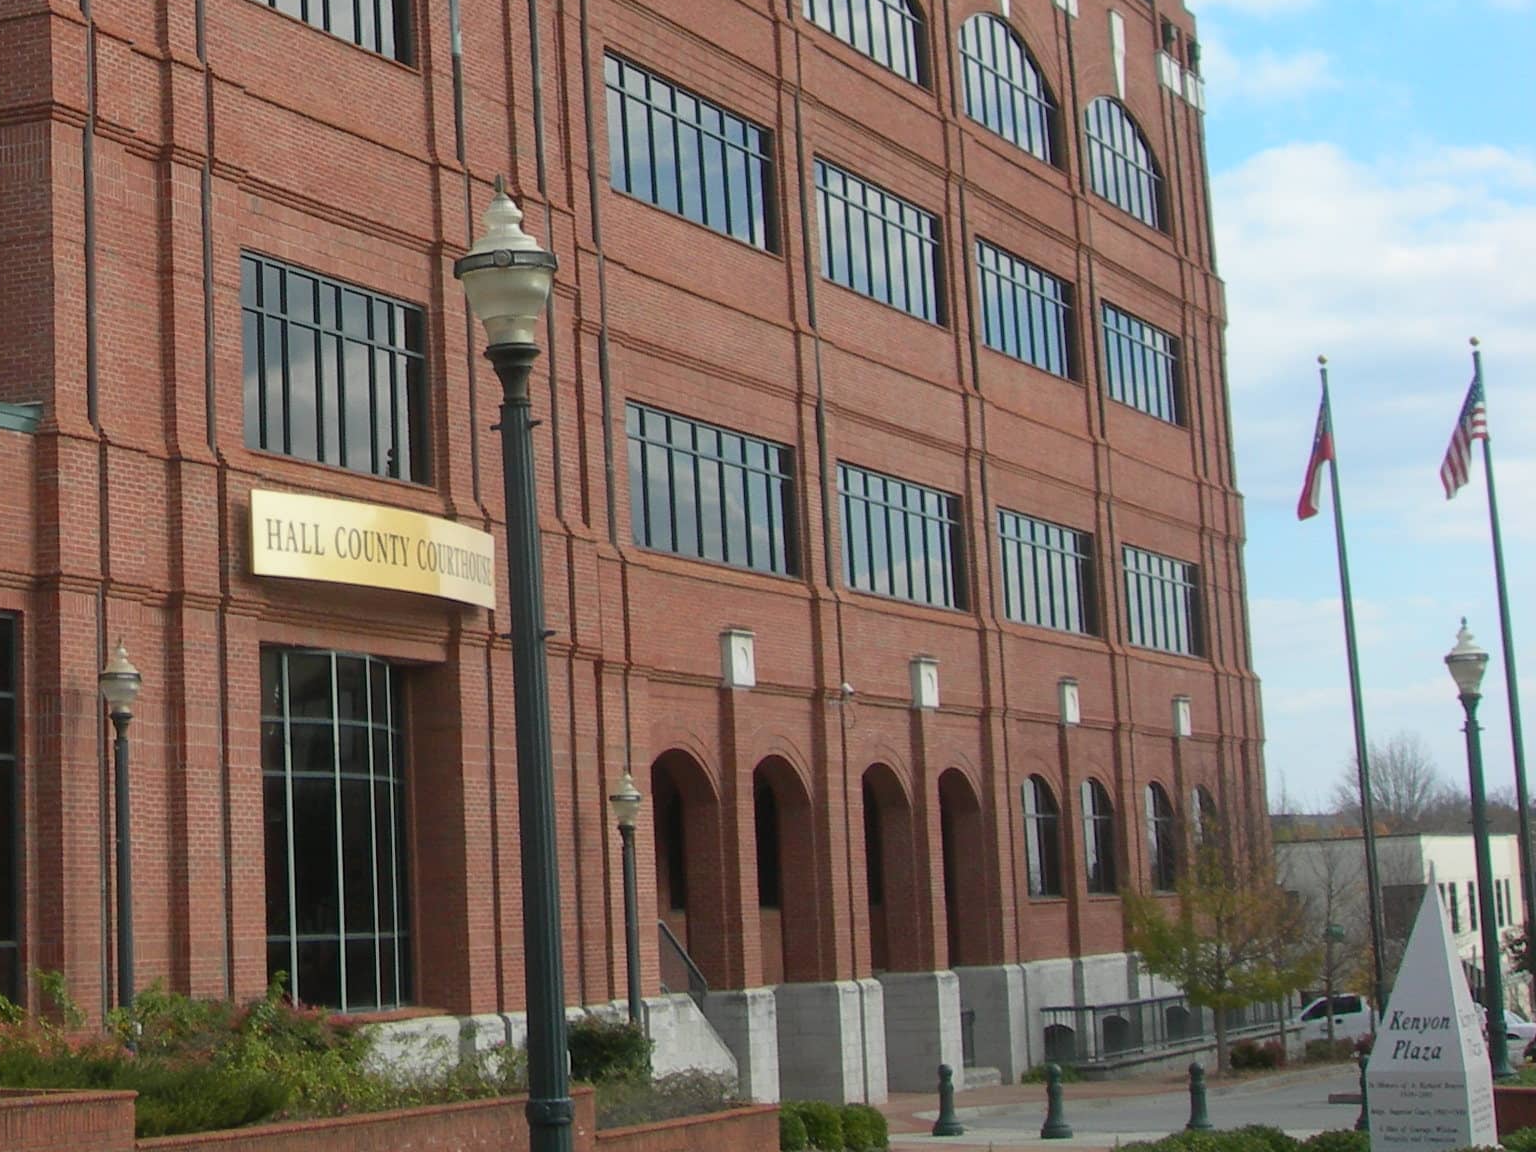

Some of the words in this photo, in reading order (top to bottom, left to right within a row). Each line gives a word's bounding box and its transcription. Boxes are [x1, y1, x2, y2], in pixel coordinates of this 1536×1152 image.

[265, 518, 325, 556] HALL
[334, 526, 410, 567] COUNTY
[417, 538, 492, 587] COURTHOUSE
[1389, 1011, 1450, 1033] Kenyon
[1392, 1040, 1442, 1060] Plaza
